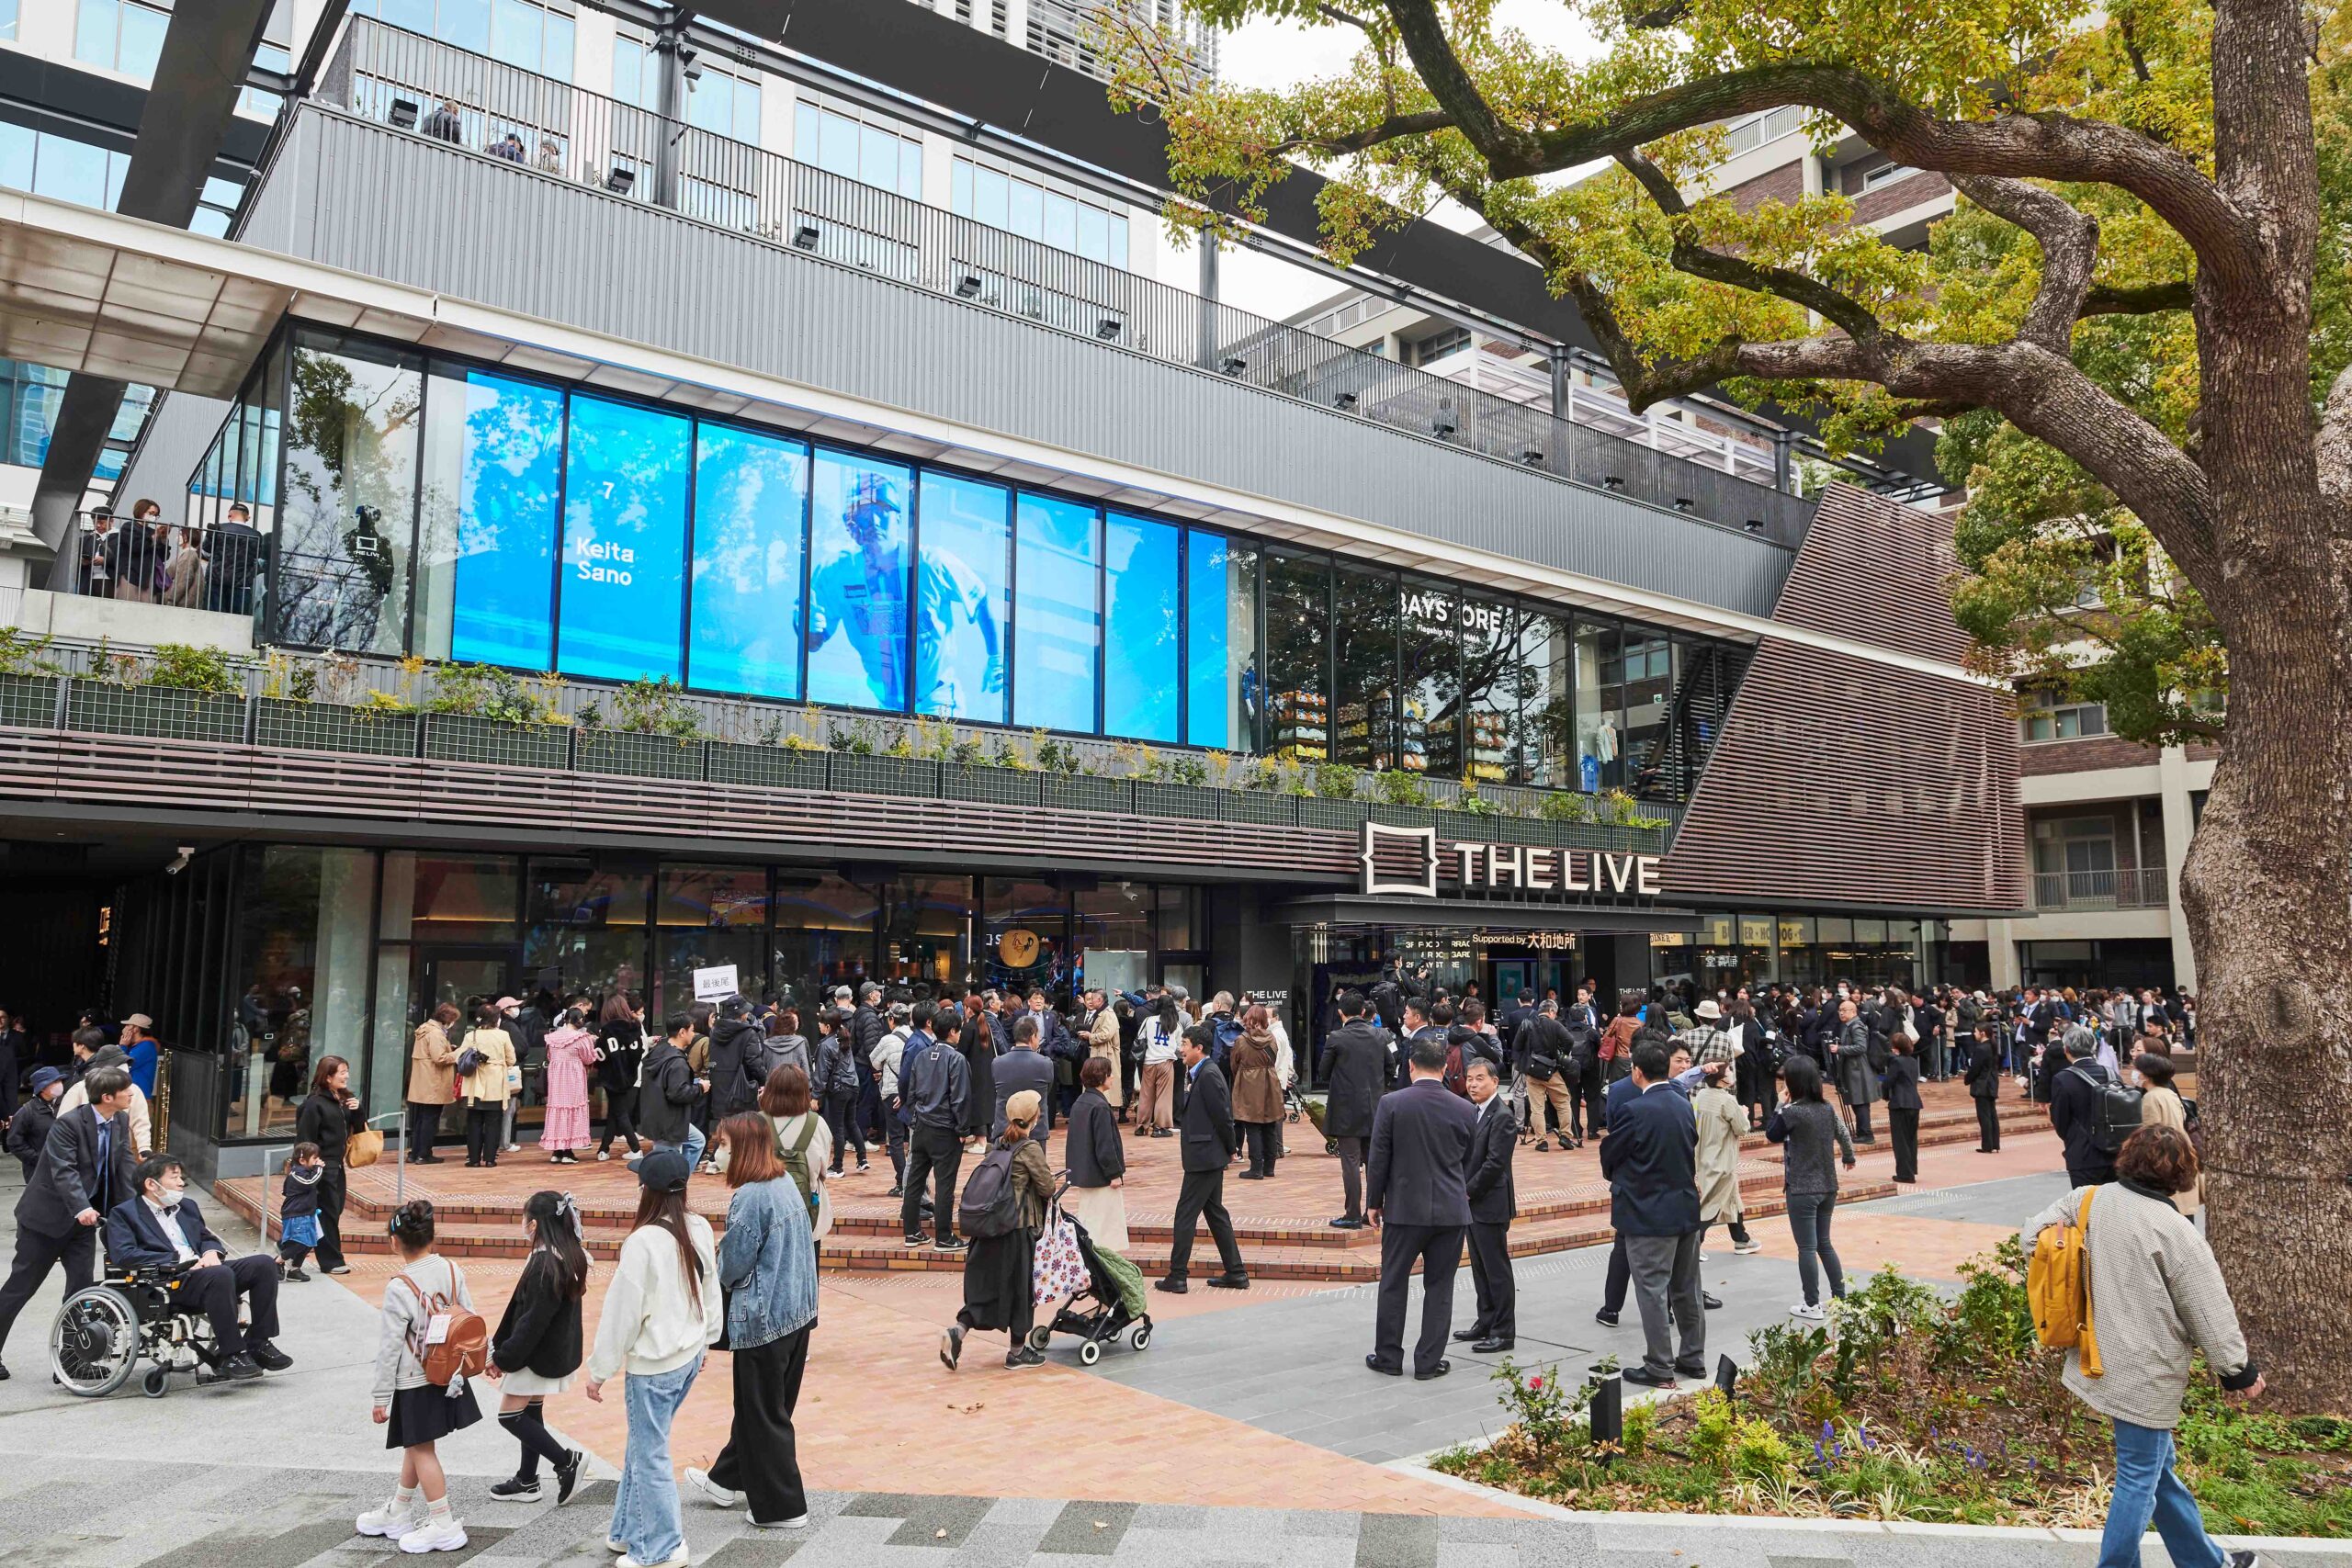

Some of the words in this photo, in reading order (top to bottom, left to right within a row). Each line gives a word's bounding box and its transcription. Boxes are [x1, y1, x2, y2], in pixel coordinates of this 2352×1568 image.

[603, 481, 615, 500] 7
[576, 536, 635, 563] Keita
[577, 559, 632, 585] Sano
[1417, 624, 1443, 637] Flagship
[1453, 842, 1554, 889] THE
[1564, 850, 1662, 895] LIVE
[1472, 934, 1515, 944] Supported
[1516, 935, 1526, 945] by
[1527, 932, 1576, 950] 大和地所
[703, 976, 729, 989] 最後尾
[1266, 990, 1287, 999] LIVE
